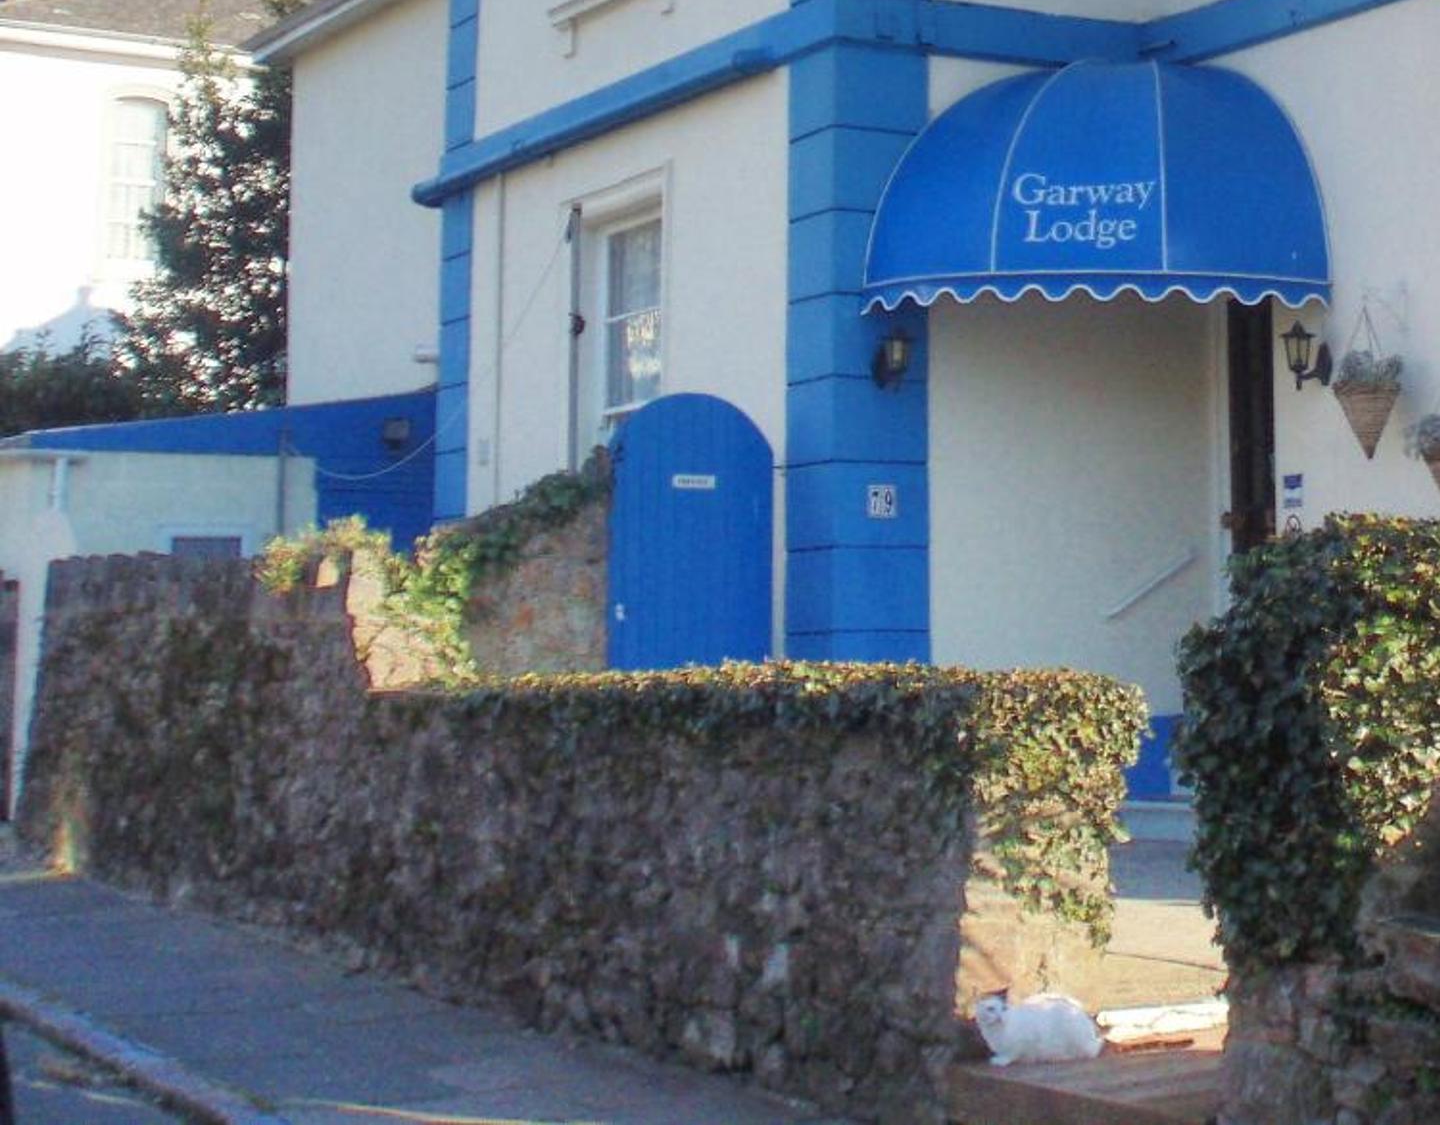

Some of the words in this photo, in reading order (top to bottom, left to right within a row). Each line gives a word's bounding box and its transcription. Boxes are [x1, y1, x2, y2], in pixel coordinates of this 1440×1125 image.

[1012, 172, 1156, 210] Garway
[1023, 208, 1138, 249] Lodge
[871, 489, 893, 514] 79
